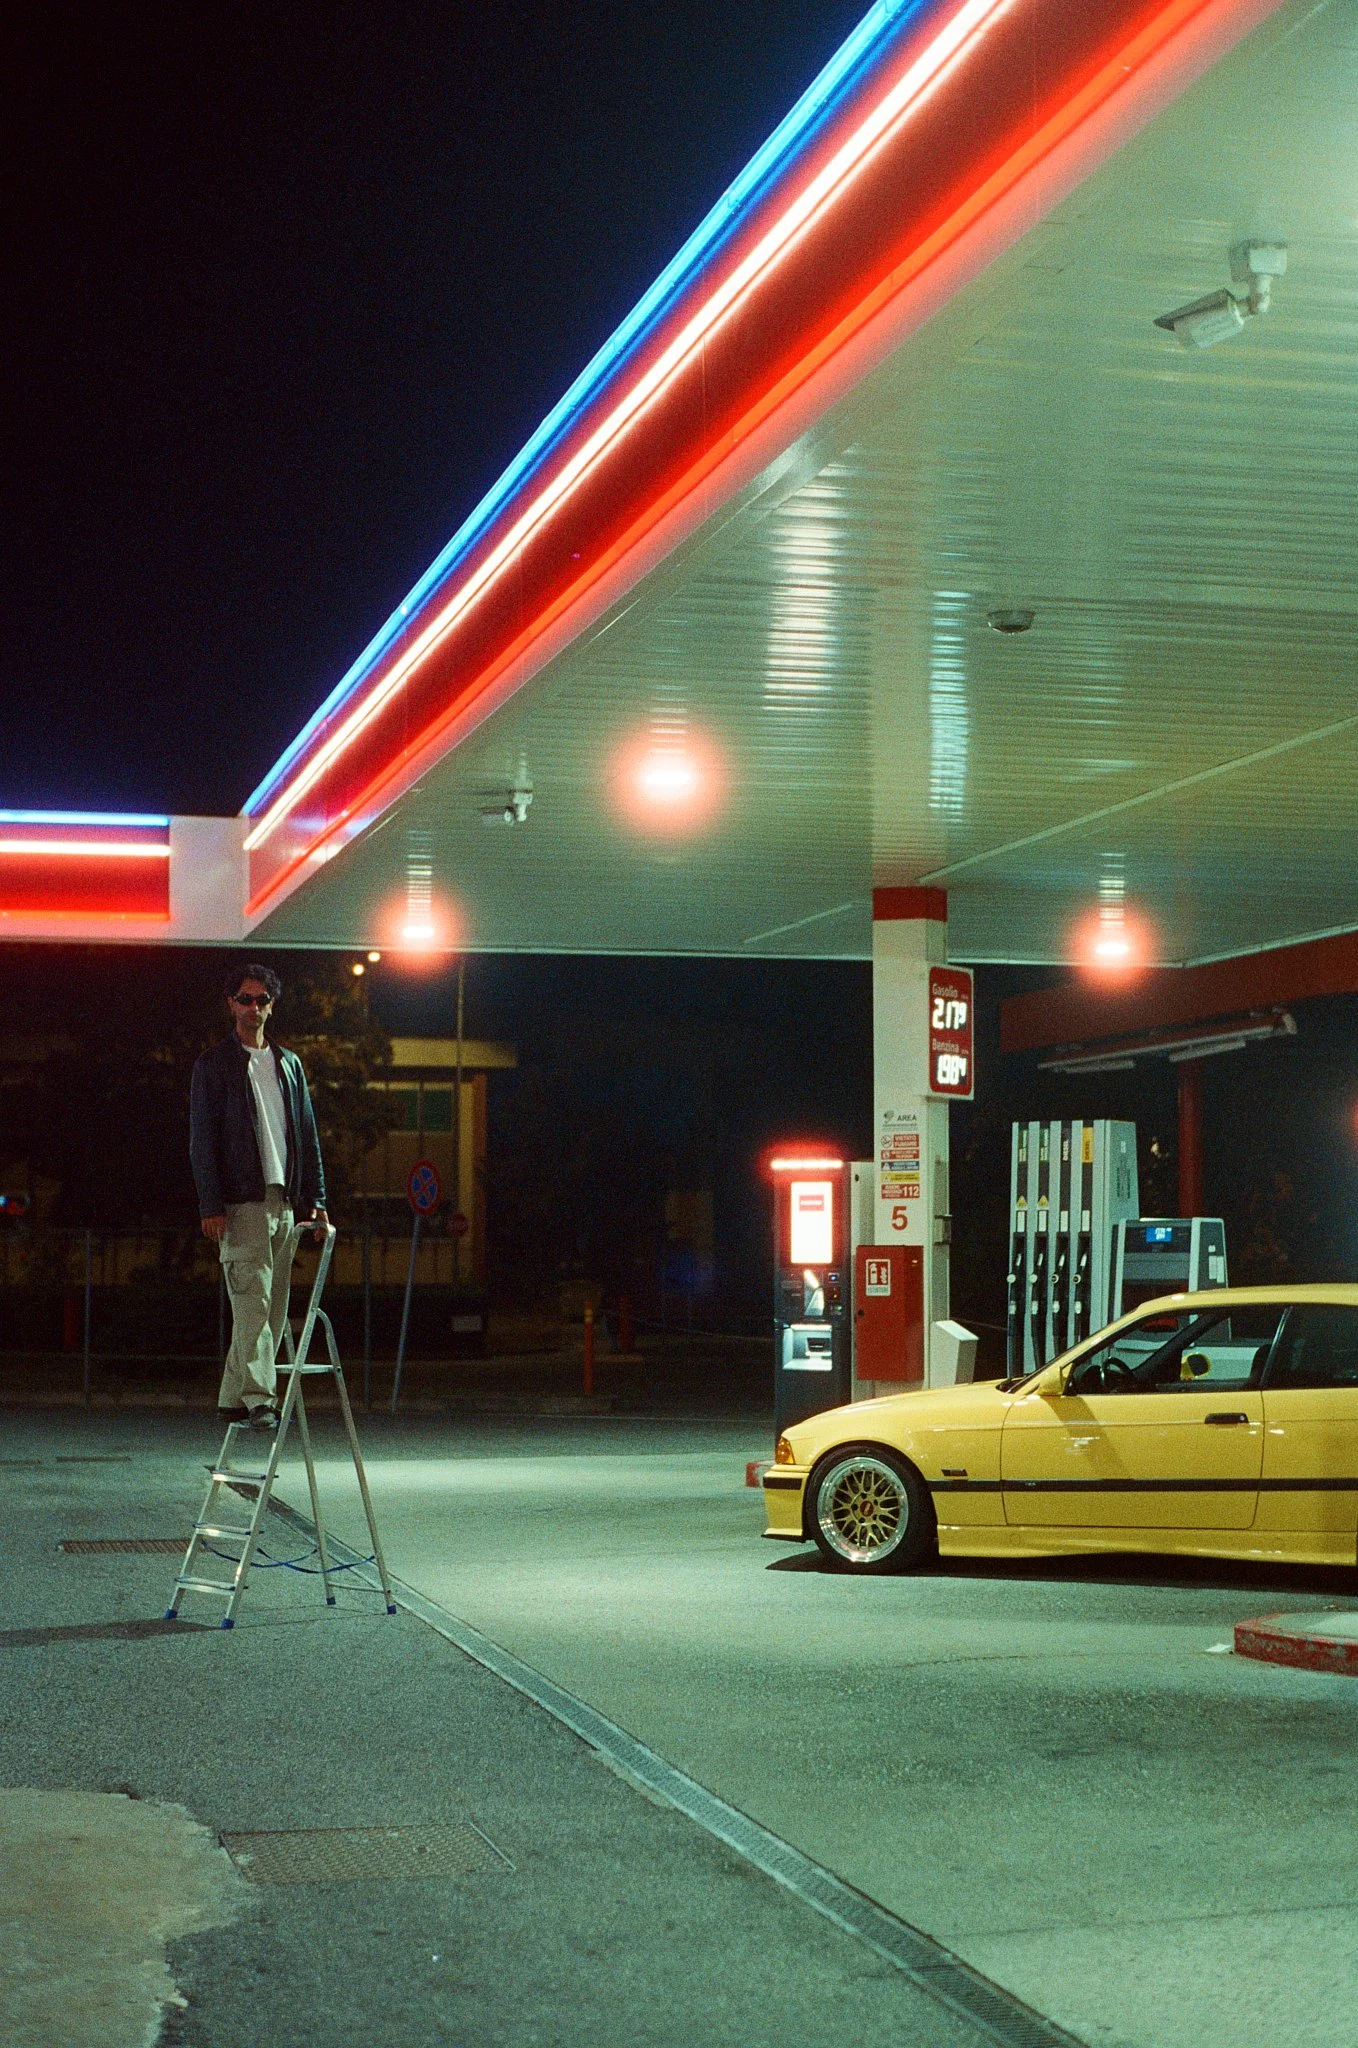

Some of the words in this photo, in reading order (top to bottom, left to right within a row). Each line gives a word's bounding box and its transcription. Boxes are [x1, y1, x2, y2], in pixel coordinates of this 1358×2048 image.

[932, 1038, 960, 1053] Benzina
[903, 1186, 919, 1197] 112
[892, 1206, 908, 1230] 5
